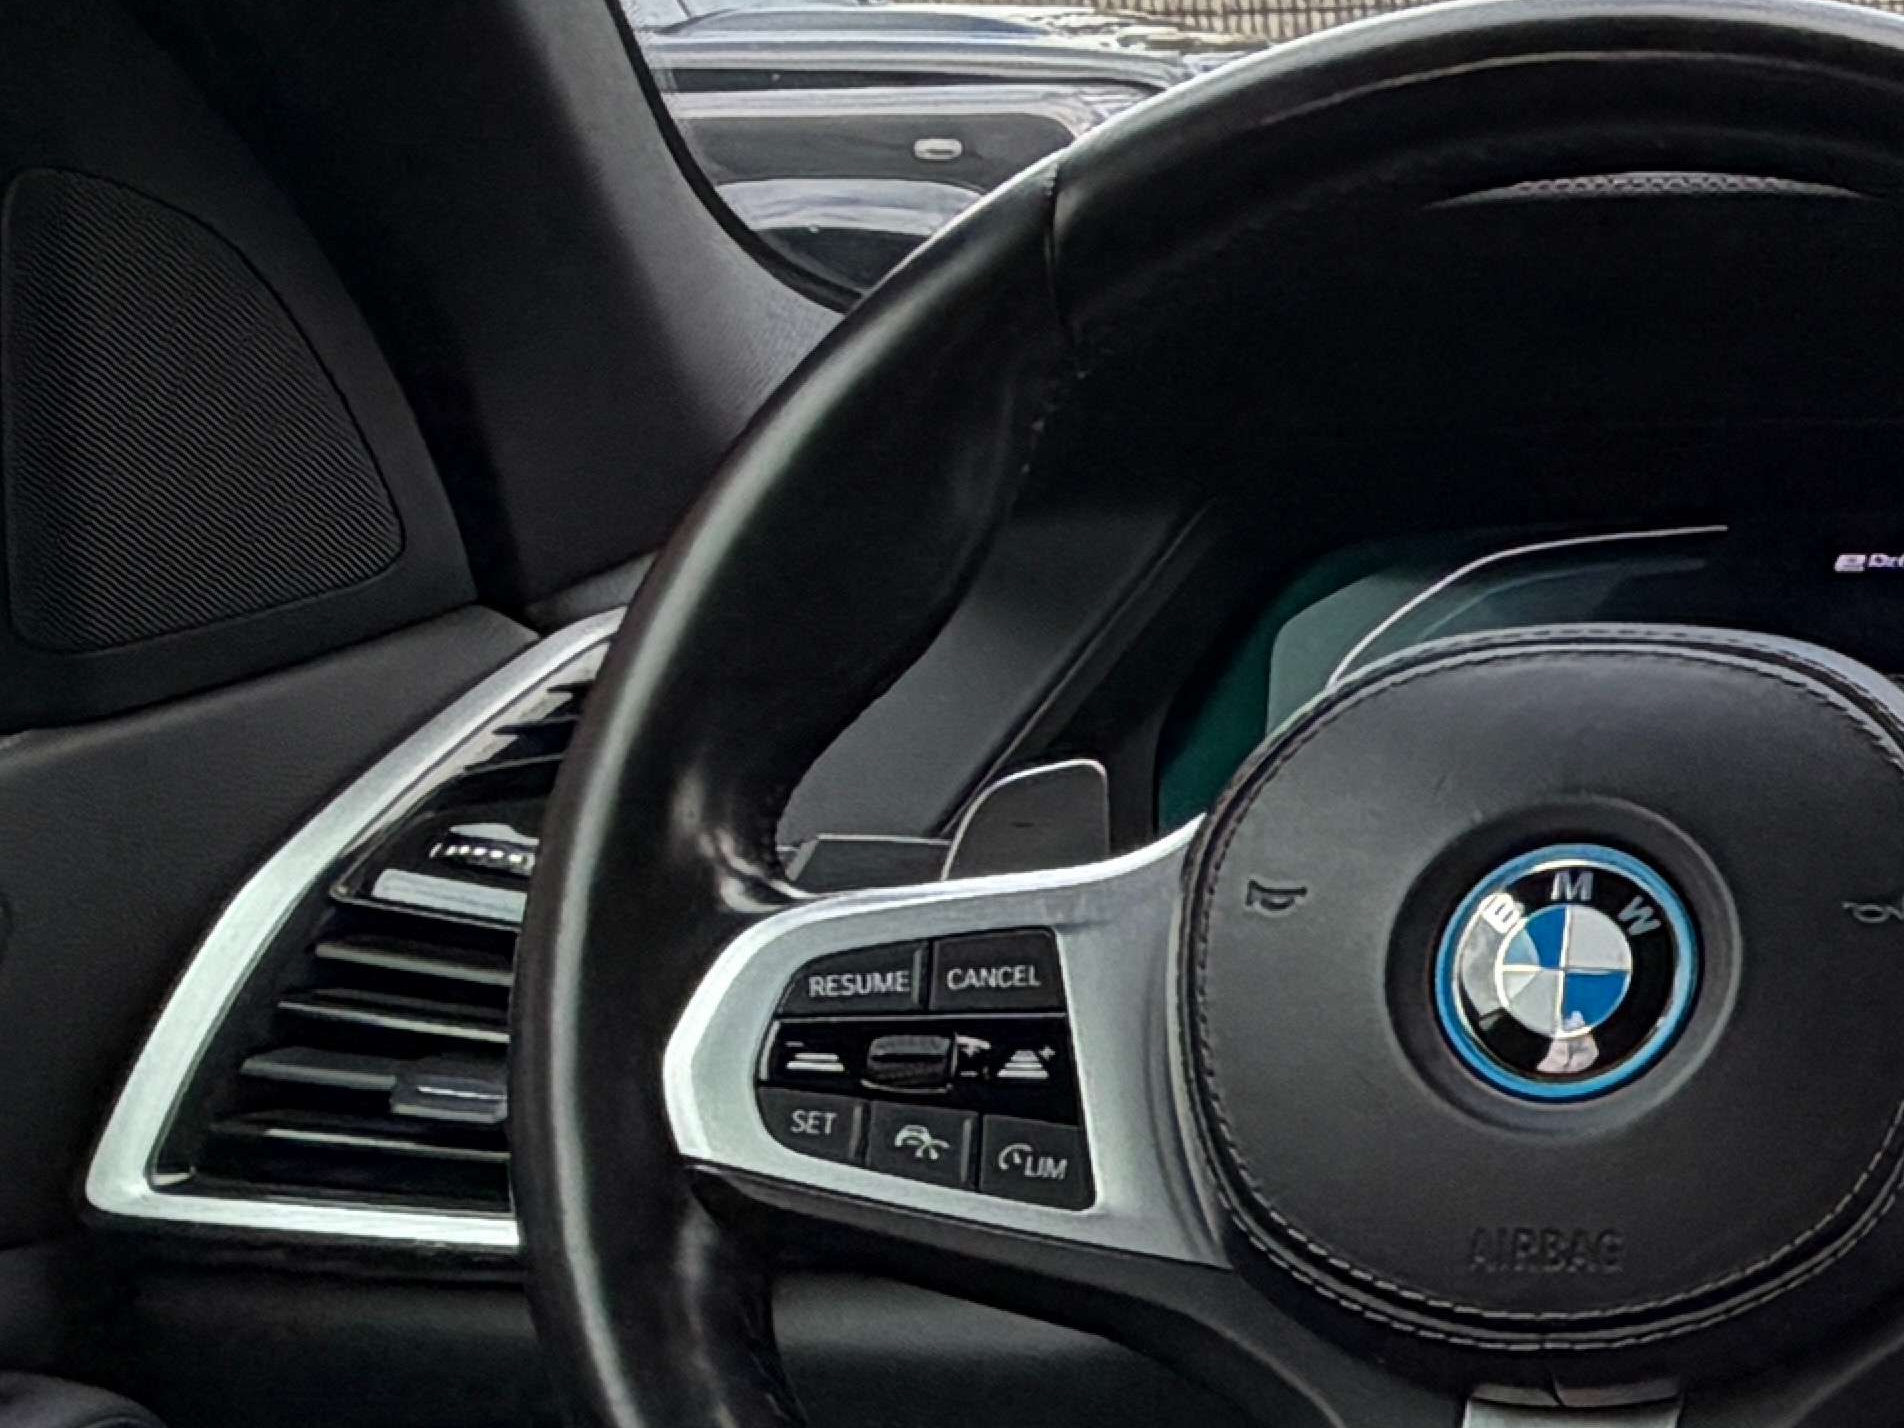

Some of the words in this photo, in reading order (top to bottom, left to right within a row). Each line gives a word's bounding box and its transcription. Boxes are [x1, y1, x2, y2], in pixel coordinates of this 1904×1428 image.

[1482, 870, 1662, 936] BMW
[808, 970, 910, 998] RESUME
[946, 964, 1042, 991] CANCEL
[788, 1108, 838, 1135] SET
[1024, 1155, 1068, 1180] LIM
[1470, 1226, 1625, 1273] AIRBAG
